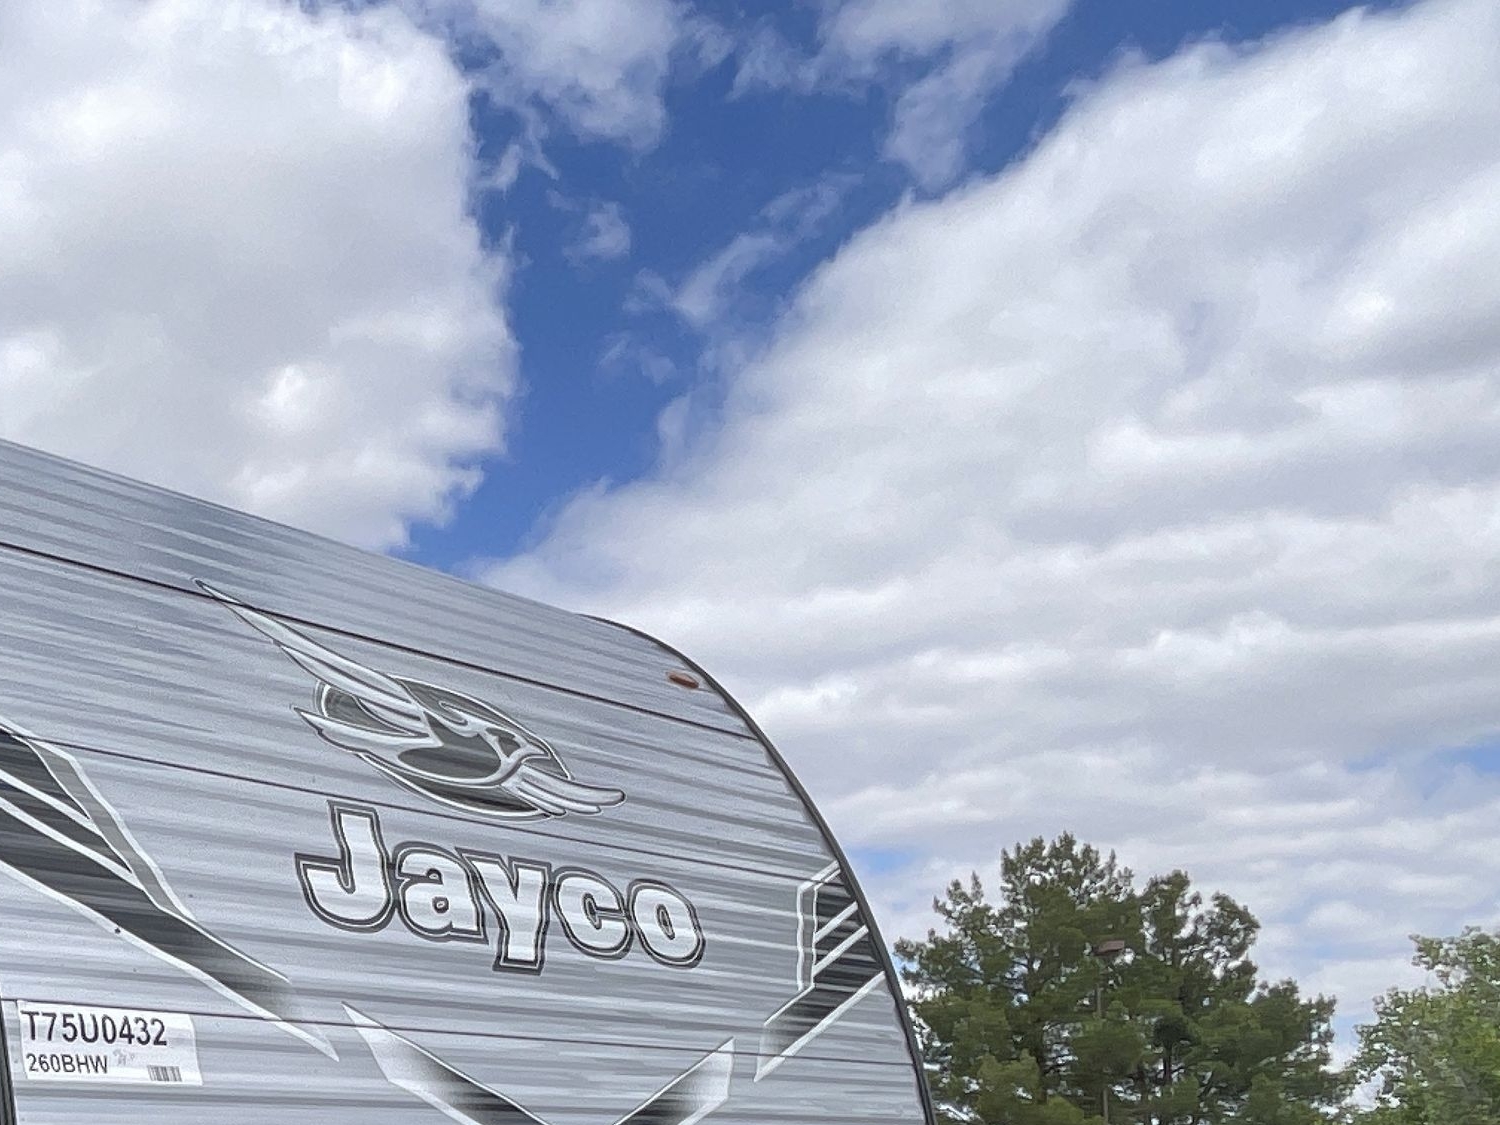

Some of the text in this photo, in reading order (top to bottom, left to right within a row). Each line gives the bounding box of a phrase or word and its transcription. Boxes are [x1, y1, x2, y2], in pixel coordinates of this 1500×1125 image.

[294, 800, 706, 975] Jayco
[20, 1010, 167, 1046] T75U0432
[26, 1053, 108, 1074] 260BHW
